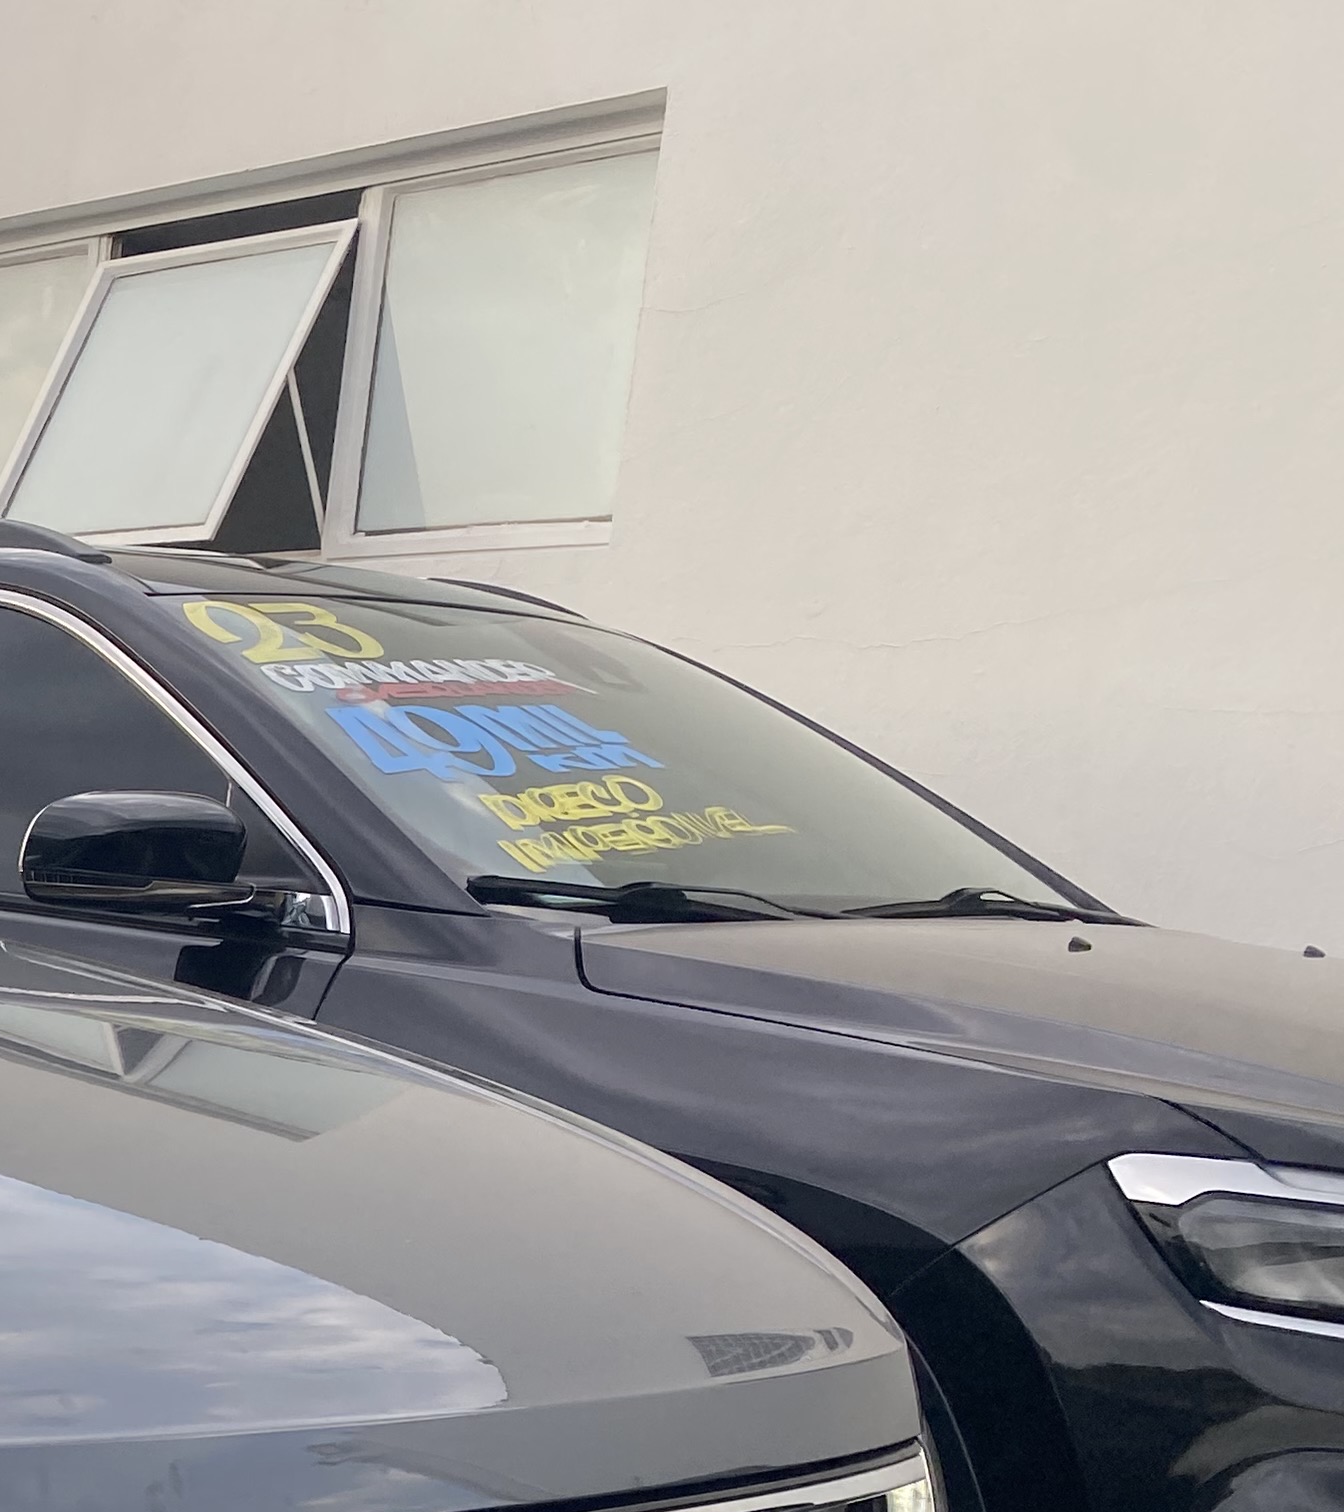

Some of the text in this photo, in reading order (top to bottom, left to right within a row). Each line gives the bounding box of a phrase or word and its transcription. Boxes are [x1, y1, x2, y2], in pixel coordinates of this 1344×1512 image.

[182, 600, 385, 664] 23
[261, 659, 598, 694] COMMANDER
[325, 704, 631, 783] 49 MIL
[527, 744, 666, 774] KM
